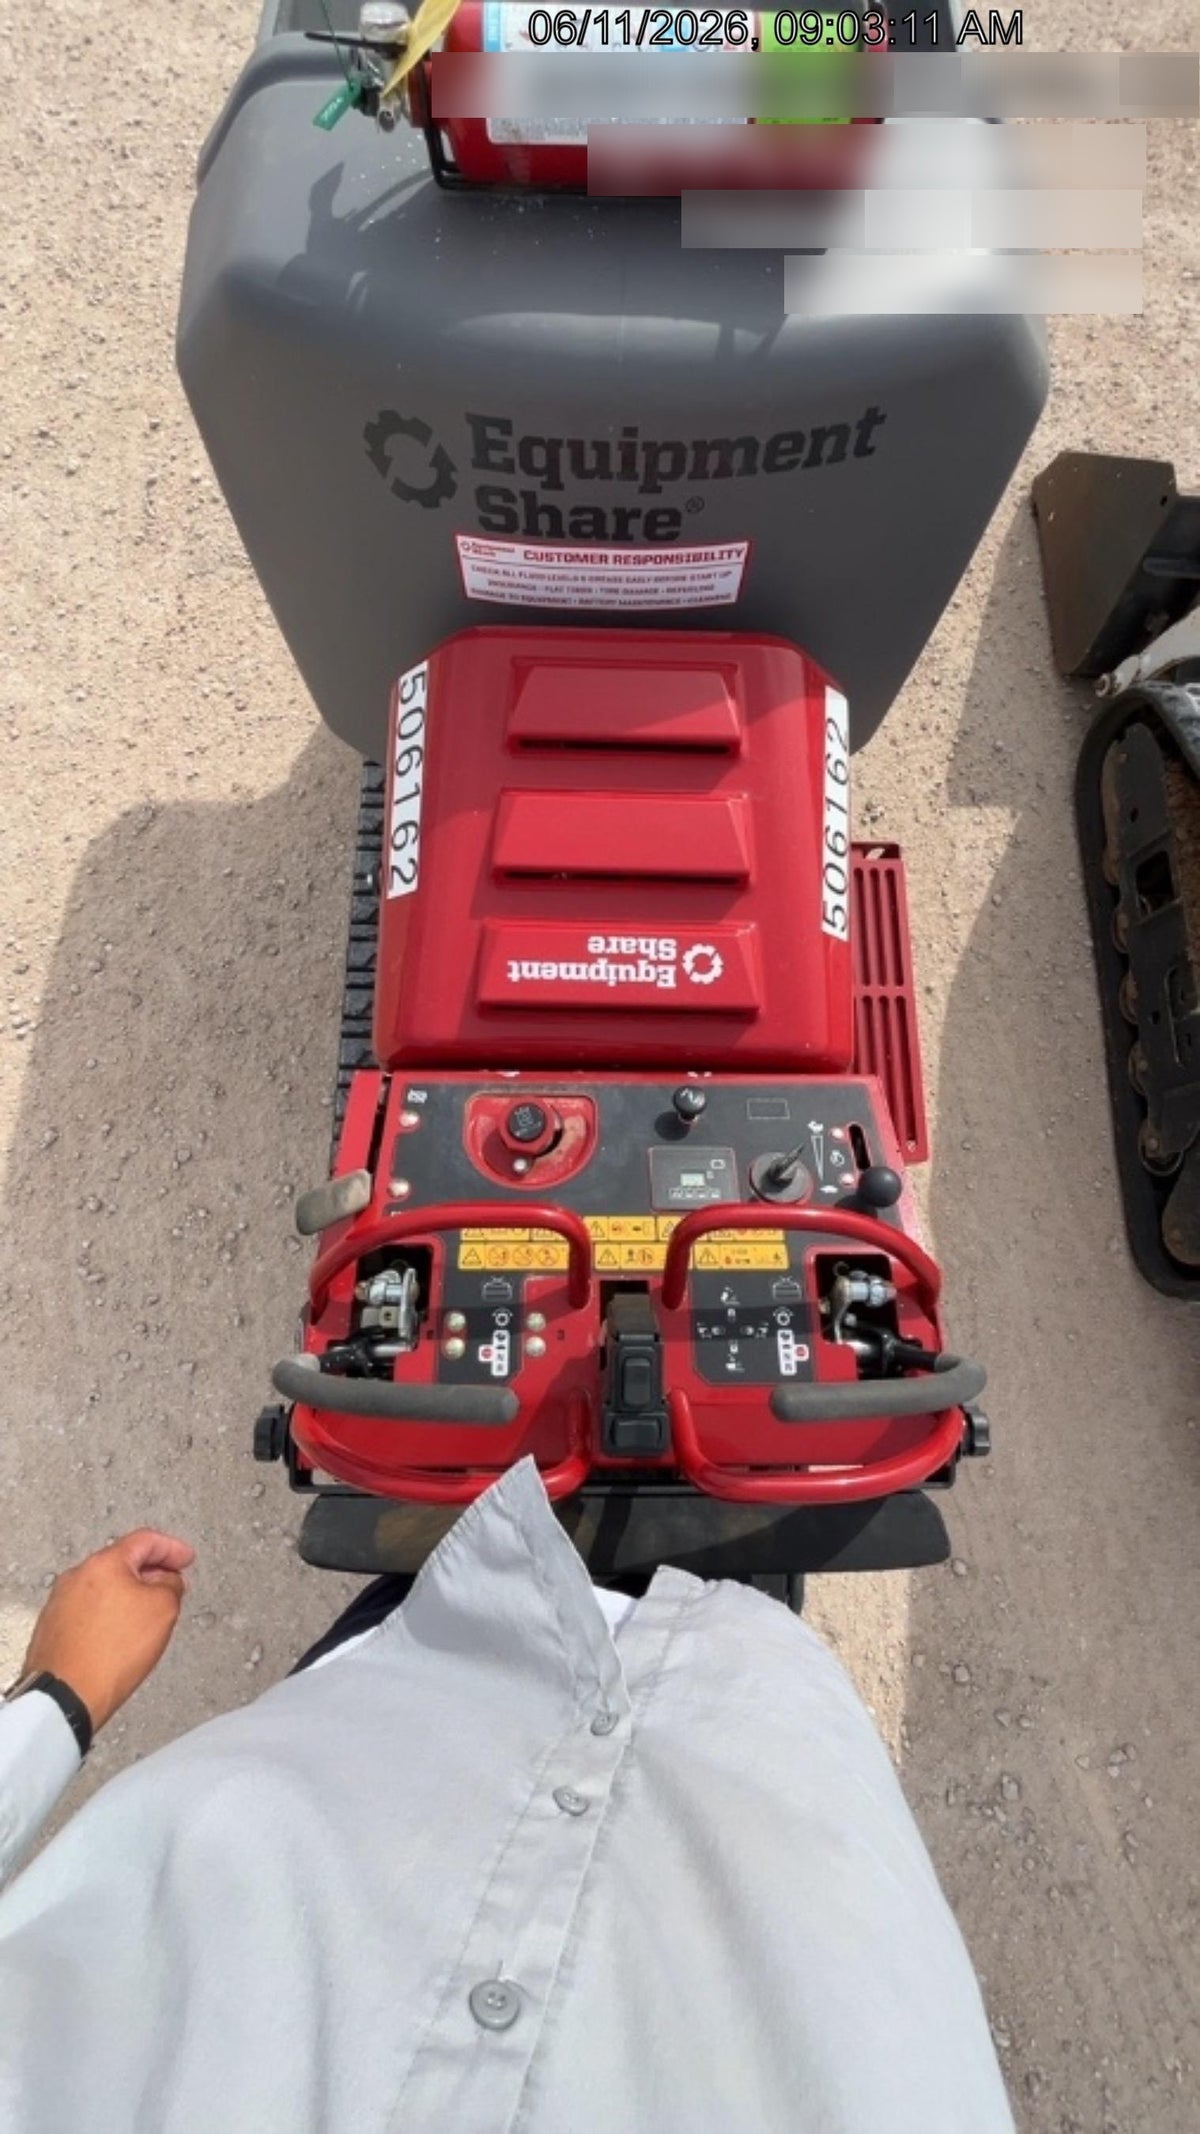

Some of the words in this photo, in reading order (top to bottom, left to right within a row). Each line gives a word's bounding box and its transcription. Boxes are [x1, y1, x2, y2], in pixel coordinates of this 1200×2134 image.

[465, 406, 887, 493] Equipment
[523, 549, 608, 565] CUSTOMER
[613, 548, 745, 565] RESPONSIBILITY
[391, 670, 427, 891] 506162
[823, 717, 849, 933] 506162
[507, 958, 677, 988] Equipment
[588, 936, 677, 961] Share
